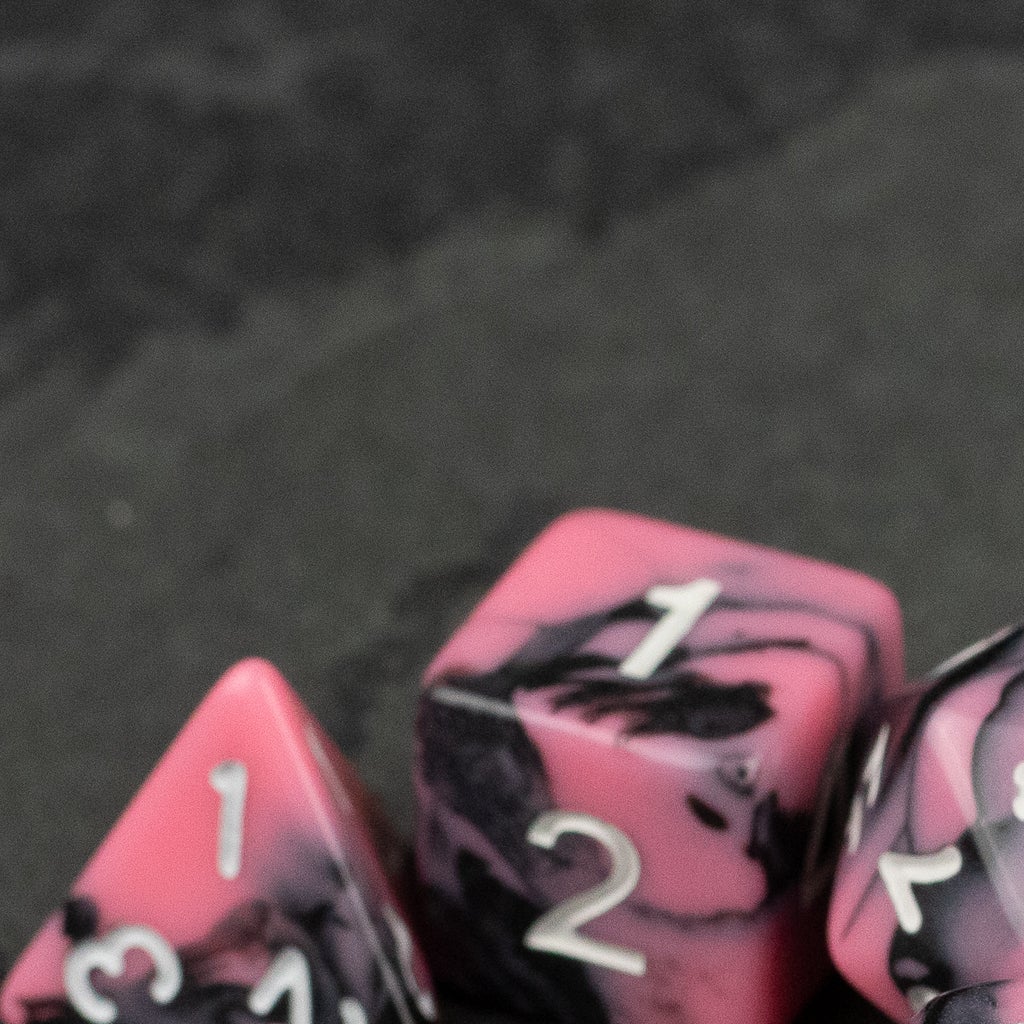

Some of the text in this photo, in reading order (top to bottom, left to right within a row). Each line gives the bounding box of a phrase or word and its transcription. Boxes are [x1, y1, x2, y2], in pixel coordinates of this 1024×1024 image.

[618, 576, 724, 680] 1
[209, 759, 248, 881] 1
[522, 811, 648, 977] 2
[877, 845, 963, 934] 7
